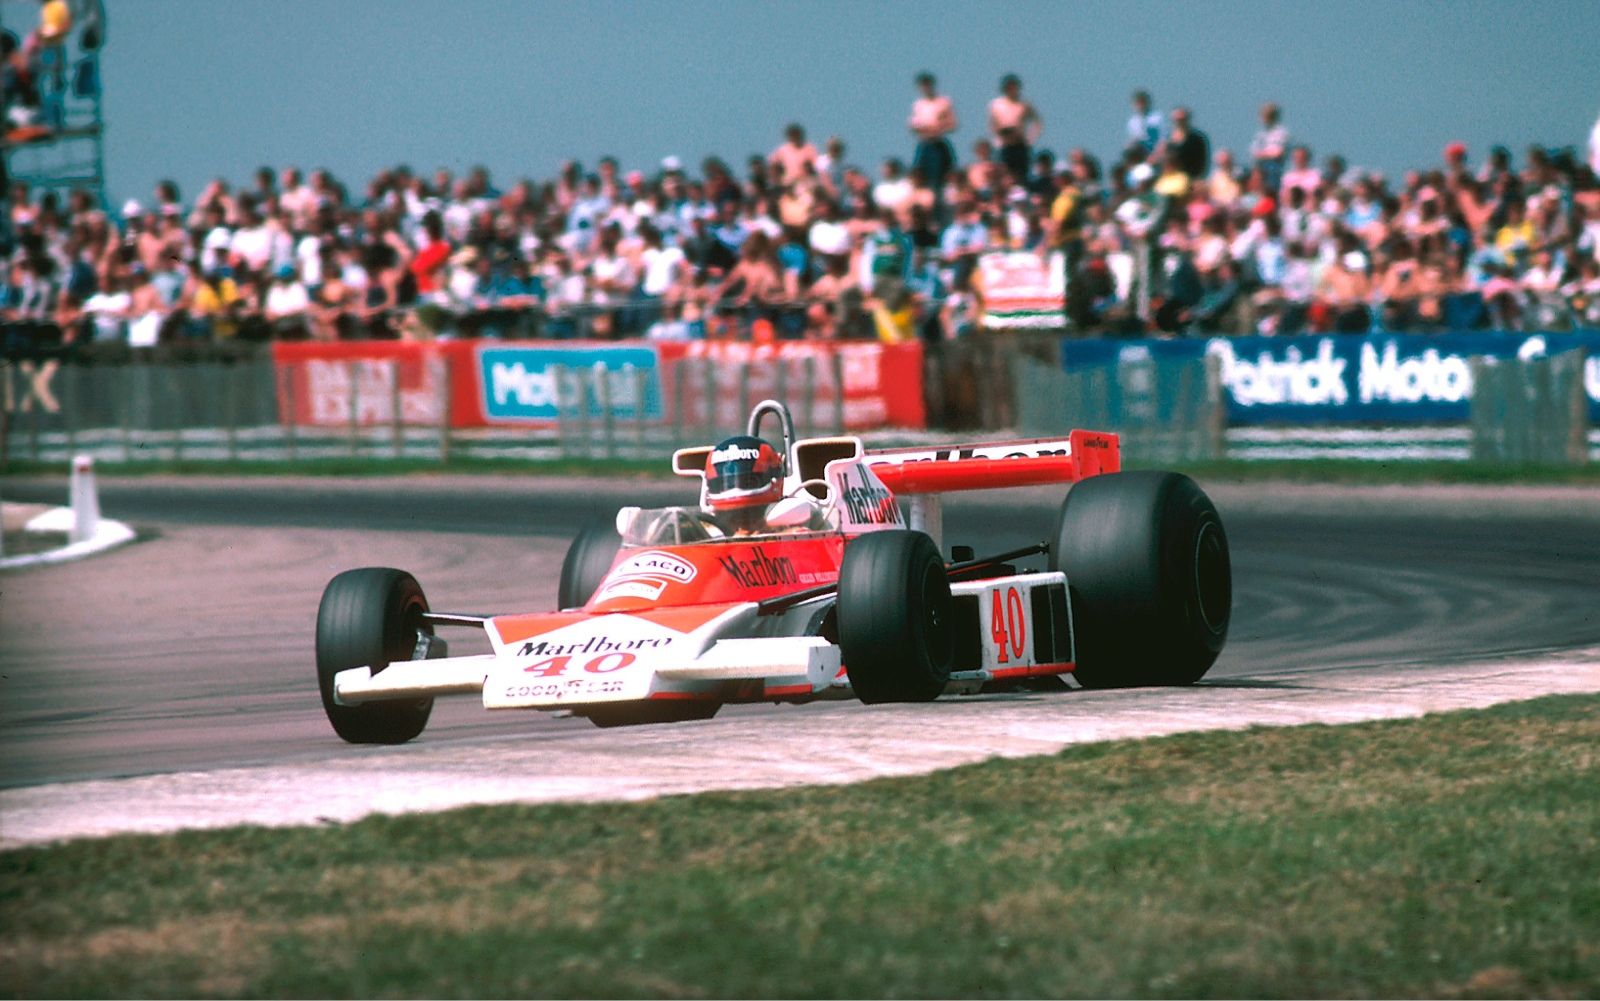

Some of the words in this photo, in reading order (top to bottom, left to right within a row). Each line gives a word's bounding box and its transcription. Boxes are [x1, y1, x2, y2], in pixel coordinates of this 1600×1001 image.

[1360, 339, 1500, 404] Moto
[516, 636, 672, 656] Marlboro
[991, 586, 1025, 663] 40
[523, 652, 636, 677] 40
